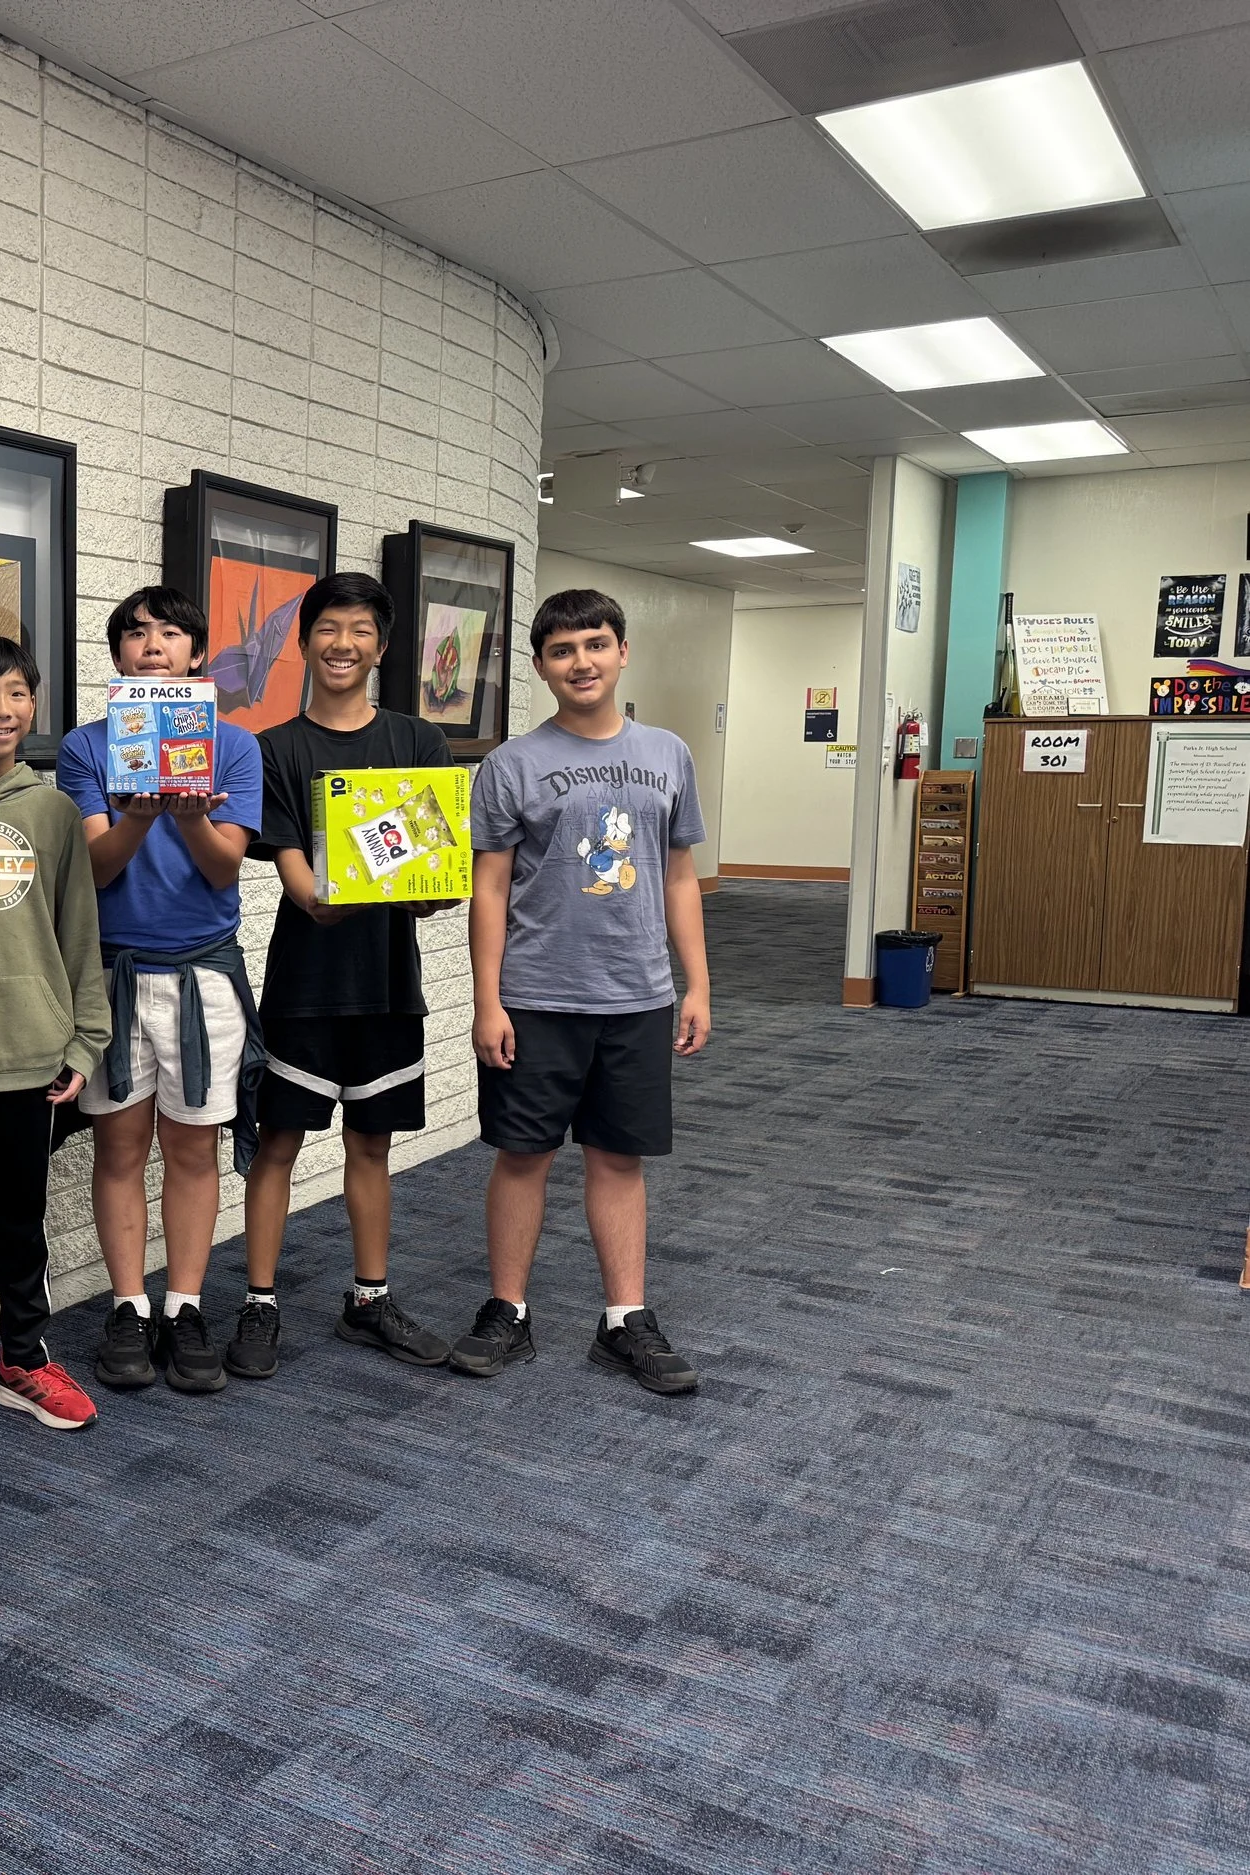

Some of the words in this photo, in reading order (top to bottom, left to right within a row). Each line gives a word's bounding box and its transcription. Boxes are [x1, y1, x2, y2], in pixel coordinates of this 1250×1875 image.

[1176, 585, 1189, 594] Be
[1191, 585, 1210, 594] the
[1168, 594, 1216, 605] REASON
[1064, 617, 1095, 625] RULES
[1165, 614, 1212, 628] SMILES
[1168, 636, 1207, 648] TODAY
[1067, 666, 1084, 675] BIG
[1203, 677, 1231, 694] the
[129, 687, 146, 698] 20
[150, 687, 193, 698] PACKS
[1153, 694, 1250, 715] IMPOSSIBLE
[173, 714, 193, 728] Chips
[1031, 736, 1080, 748] ROOM
[1040, 755, 1067, 767] 301
[537, 760, 668, 800] Disneyland
[330, 777, 347, 798] 10
[378, 820, 408, 860] POP
[3, 889, 22, 907] 1999
